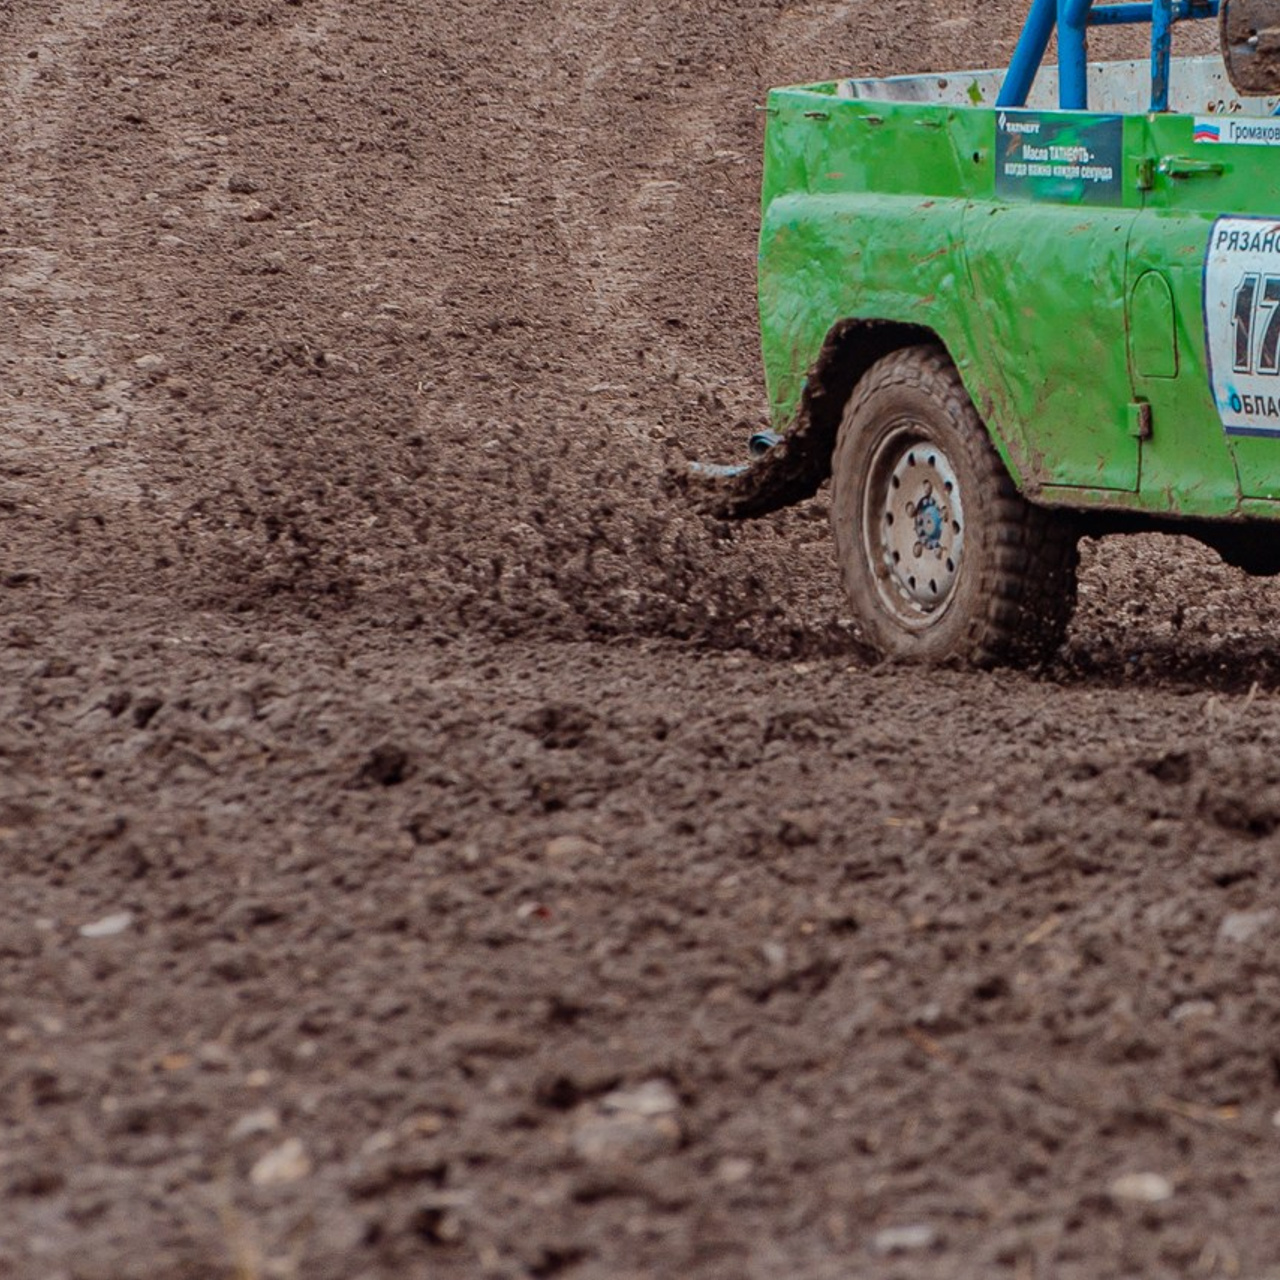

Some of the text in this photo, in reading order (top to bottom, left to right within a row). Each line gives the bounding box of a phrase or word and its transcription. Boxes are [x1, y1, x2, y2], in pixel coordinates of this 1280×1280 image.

[1230, 122, 1280, 141] Громаков
[1023, 145, 1048, 160] Масла
[1005, 163, 1112, 182] когда важно каждая секунда
